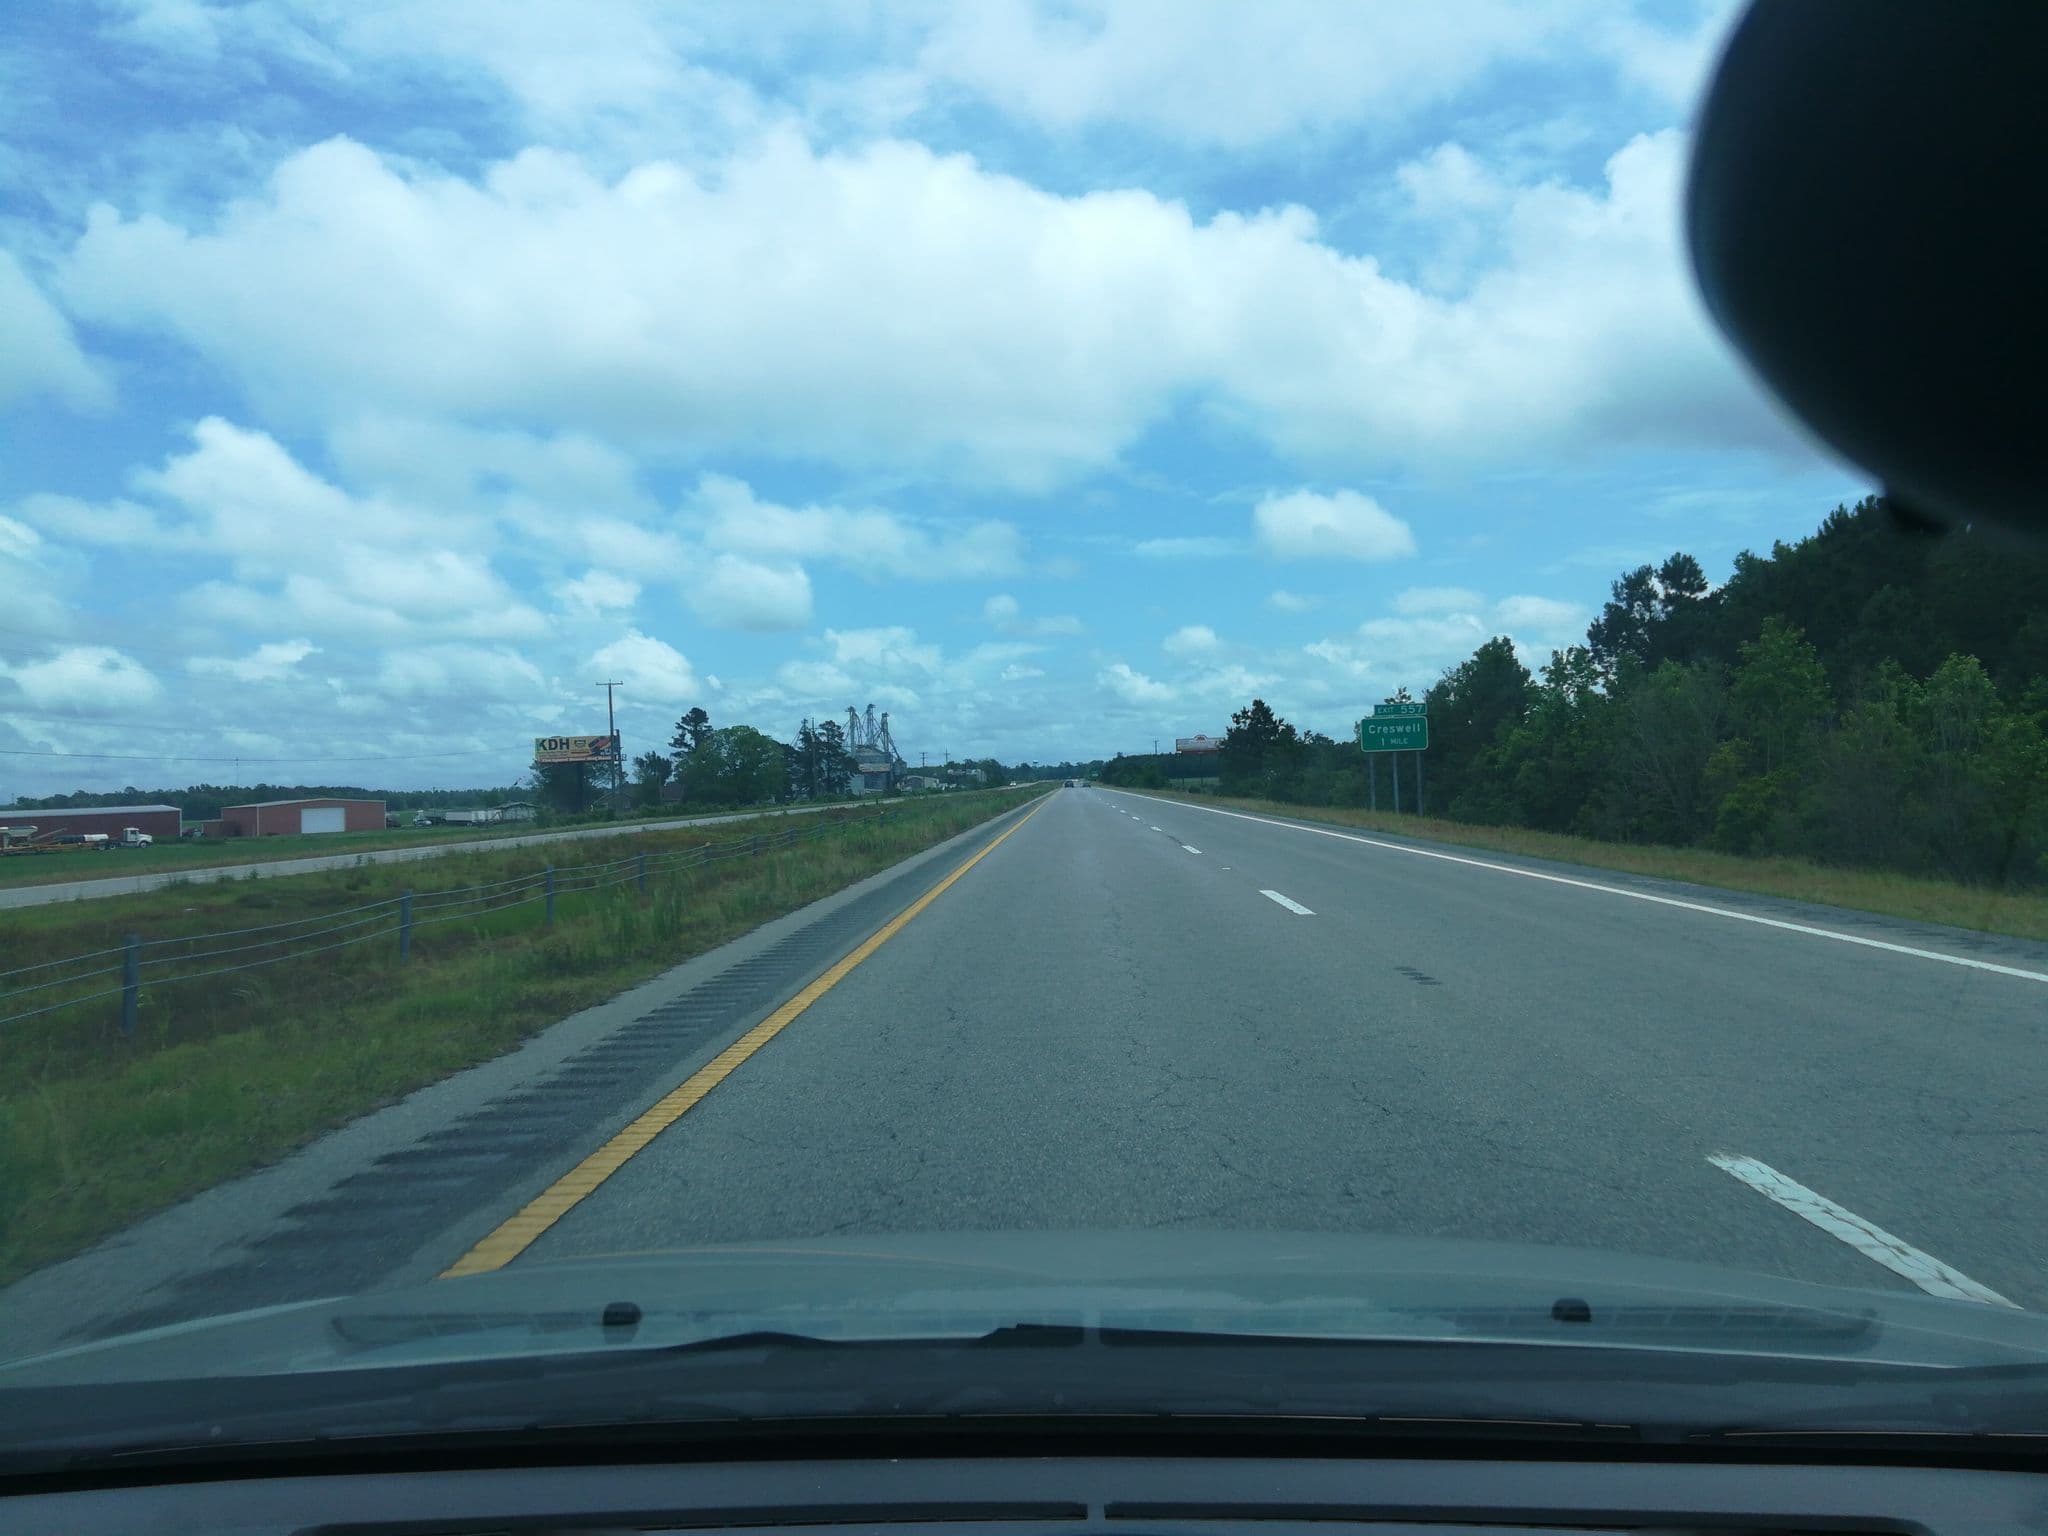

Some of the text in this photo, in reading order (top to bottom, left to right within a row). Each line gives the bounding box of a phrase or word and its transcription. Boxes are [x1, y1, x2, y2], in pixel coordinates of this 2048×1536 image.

[1368, 723, 1421, 734] Creswell
[538, 738, 570, 751] KDH
[1390, 737, 1409, 745] MILE
